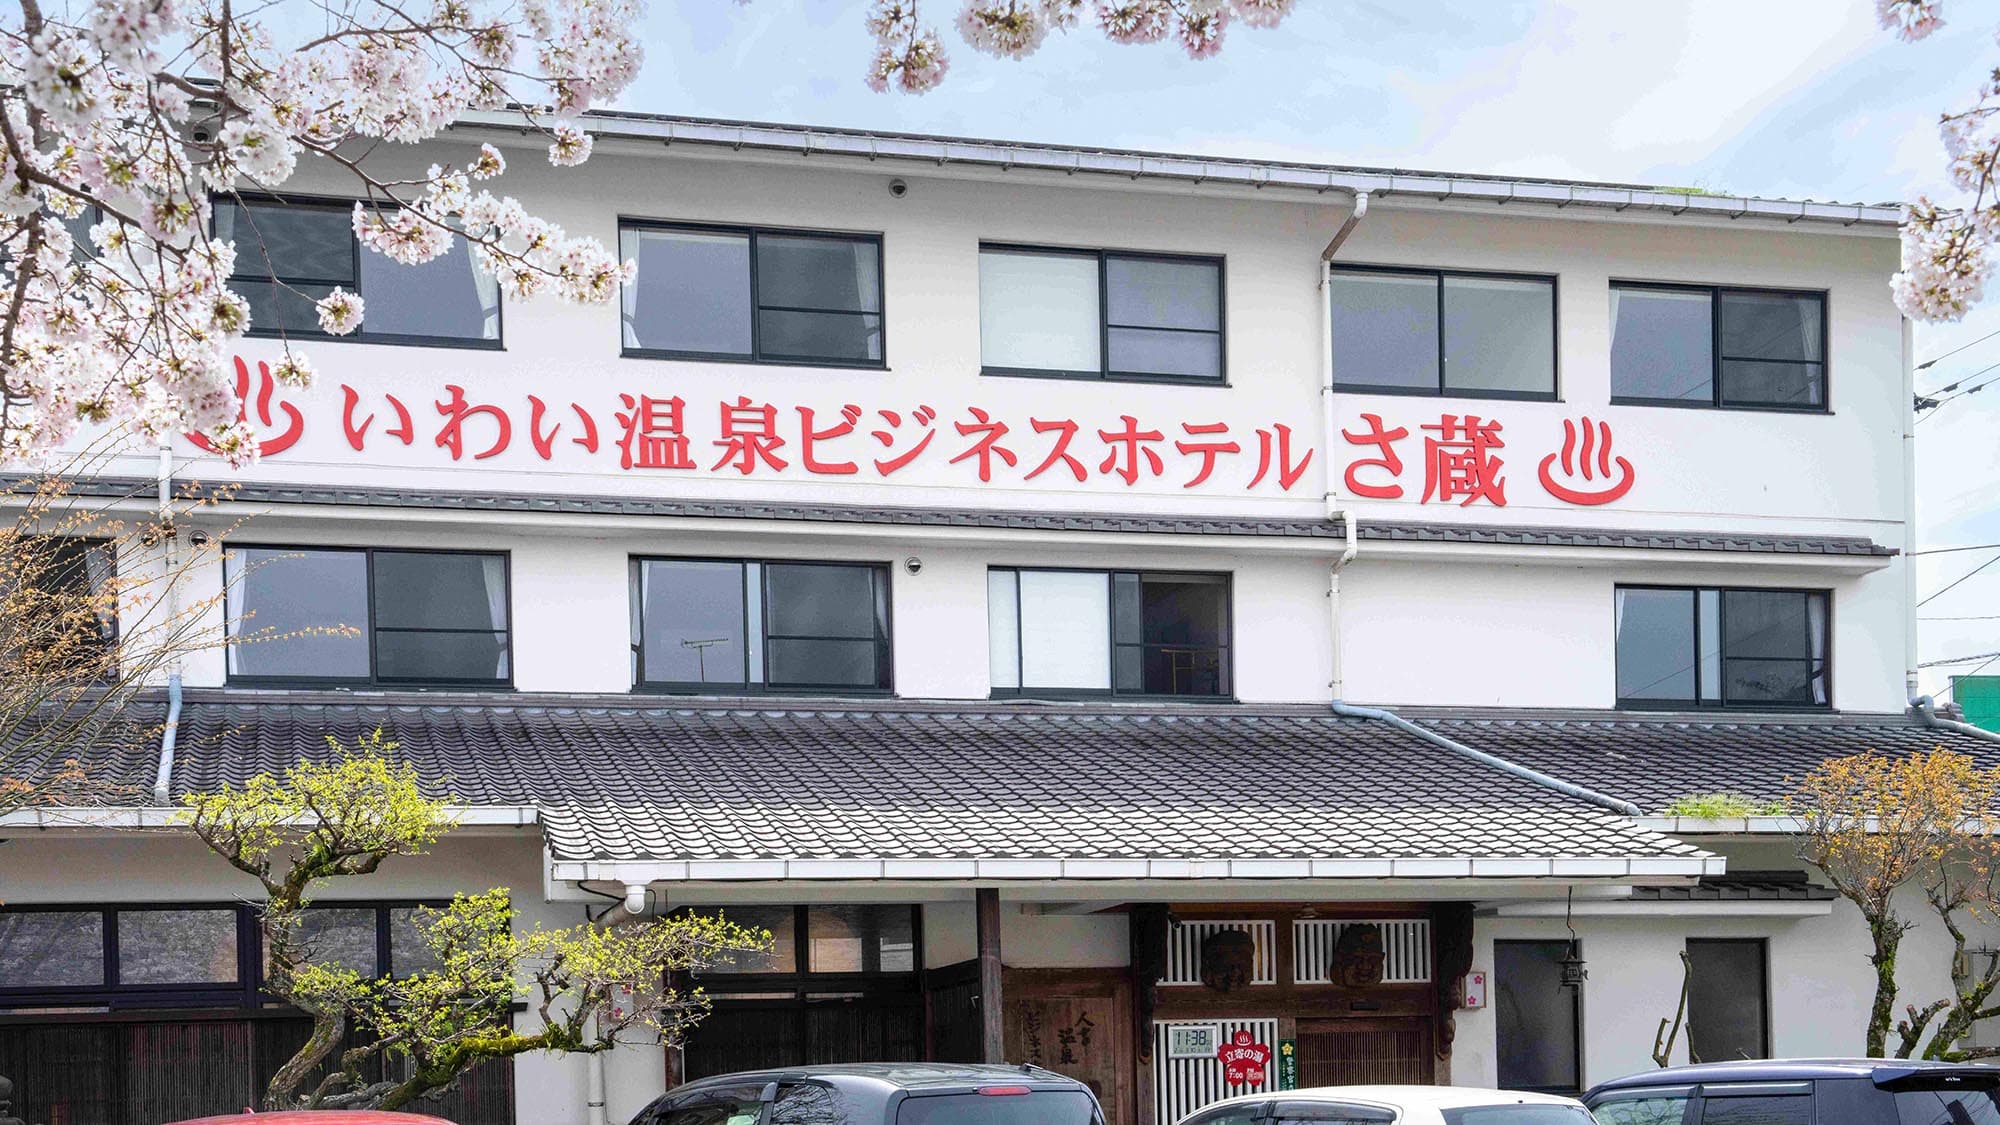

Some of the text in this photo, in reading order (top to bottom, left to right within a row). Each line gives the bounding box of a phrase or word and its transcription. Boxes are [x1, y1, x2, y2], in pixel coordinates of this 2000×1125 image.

[1177, 1030, 1207, 1046] 11:38
[1224, 1048, 1265, 1063] 立寄の湯
